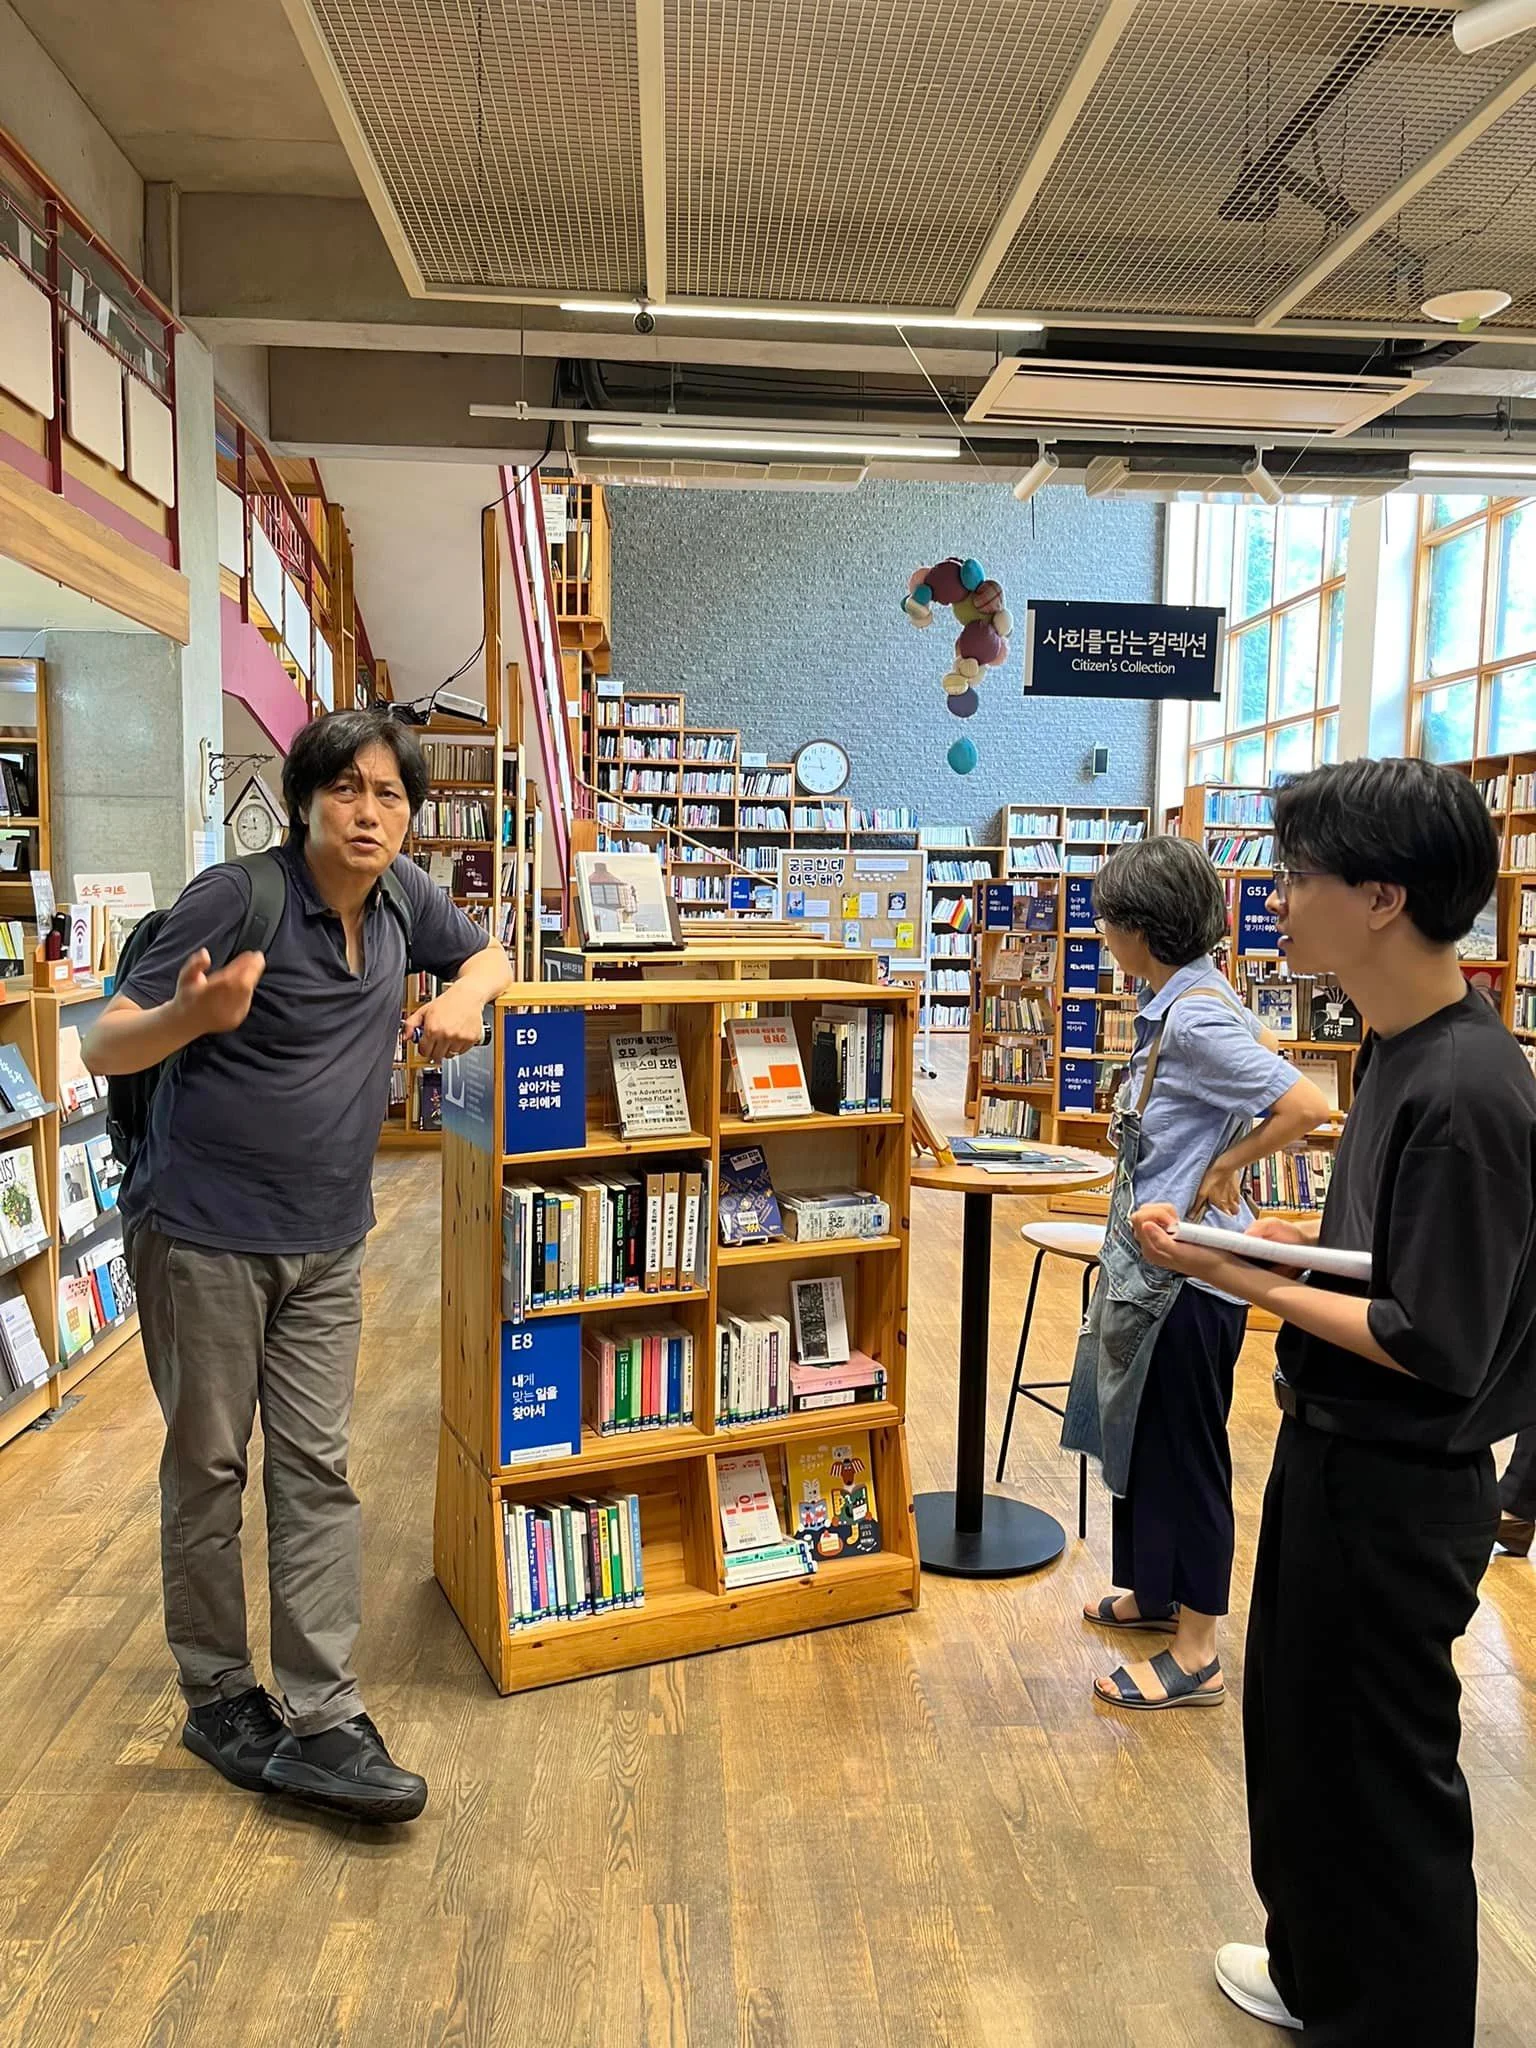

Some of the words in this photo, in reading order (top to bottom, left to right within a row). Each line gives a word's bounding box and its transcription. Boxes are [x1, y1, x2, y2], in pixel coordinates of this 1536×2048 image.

[1071, 658, 1118, 672] Citizen's
[1120, 660, 1176, 674] Collection
[81, 884, 102, 898] 소독
[104, 885, 127, 895] 키트
[1247, 886, 1268, 897] G51
[1066, 1004, 1080, 1012] C12
[516, 1028, 538, 1045] E9
[618, 1047, 638, 1059] 호모
[517, 1067, 530, 1078] AI
[532, 1063, 564, 1078] 시대를
[518, 1080, 561, 1095] 살아가는
[518, 1095, 561, 1111] 우리에게
[511, 1332, 533, 1350] E8
[511, 1373, 535, 1388] 내게
[512, 1390, 535, 1405] 맞는
[535, 1386, 558, 1401] 일을
[511, 1403, 546, 1421] 찾아서
